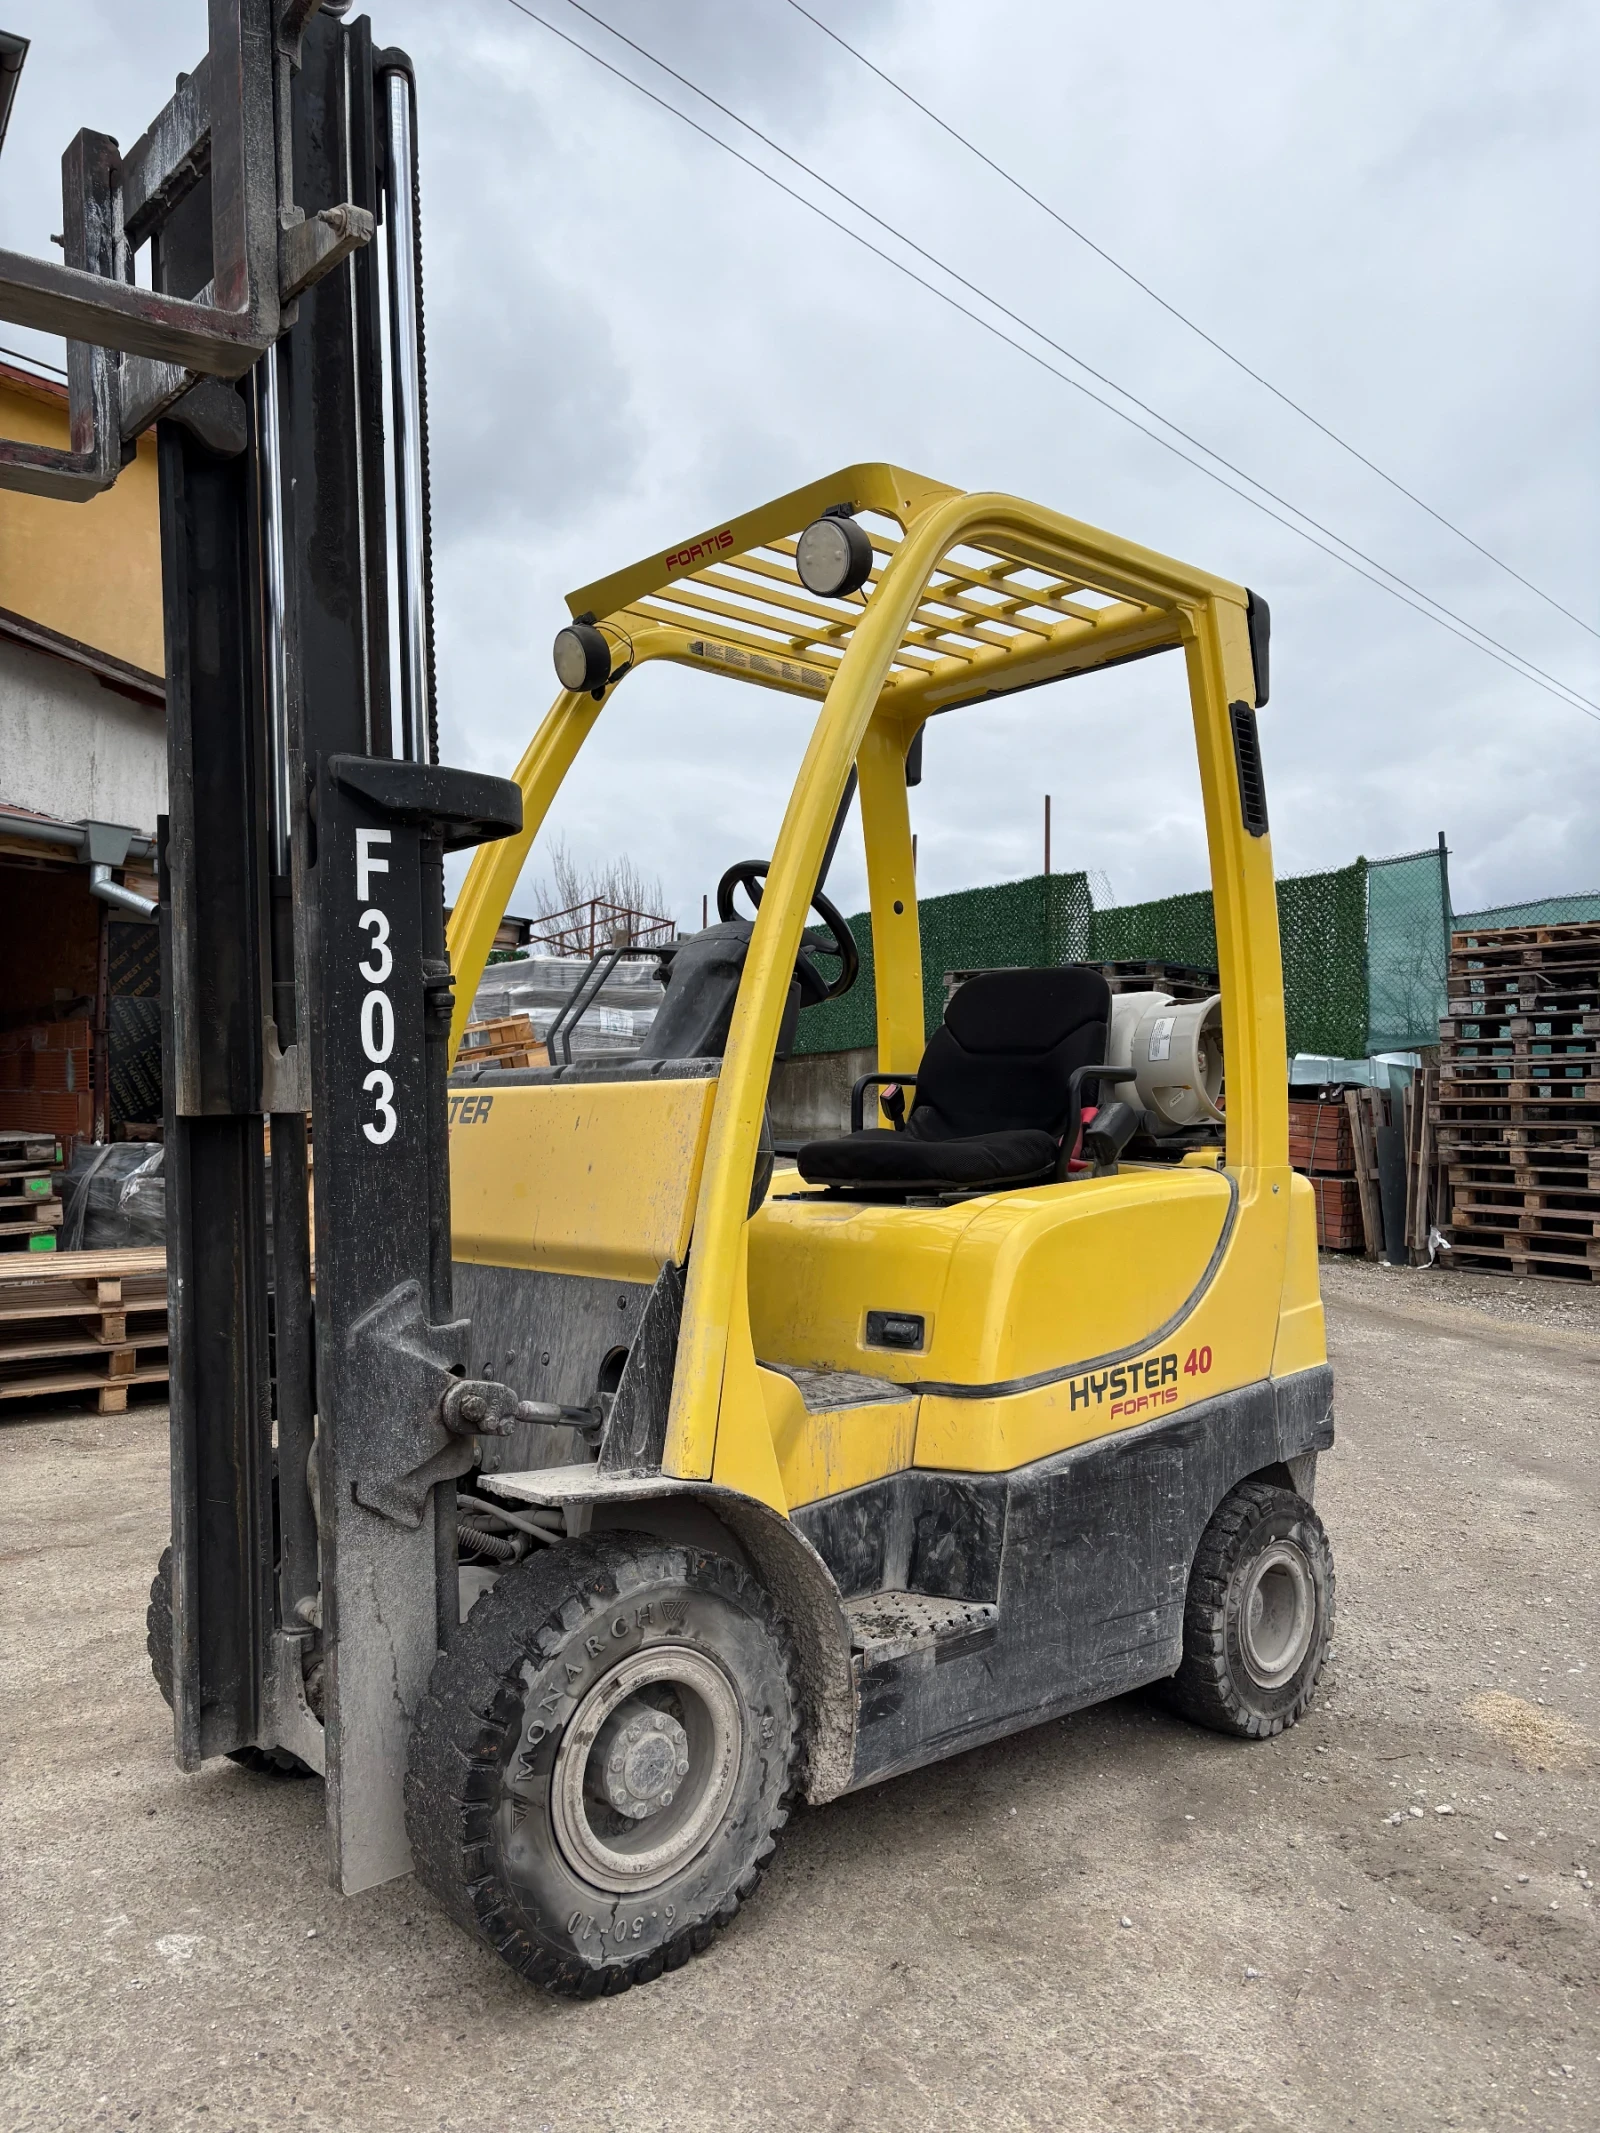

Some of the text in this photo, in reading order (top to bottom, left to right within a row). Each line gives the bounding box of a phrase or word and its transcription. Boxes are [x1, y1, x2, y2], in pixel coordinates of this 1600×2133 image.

[665, 529, 735, 572] FORTIS
[110, 962, 142, 996] AITBEST
[355, 827, 398, 1146] F303
[112, 997, 142, 1043] PHENOPL
[122, 1057, 156, 1108] PHENOPLY
[139, 1049, 163, 1089] ENOPLY
[448, 1095, 494, 1125] TER
[1069, 1345, 1213, 1412] HYSTER 40
[1110, 1386, 1178, 1420] FORTIS
[515, 1601, 655, 1783] MONARCH
[566, 1903, 677, 1943] 6.50-10
